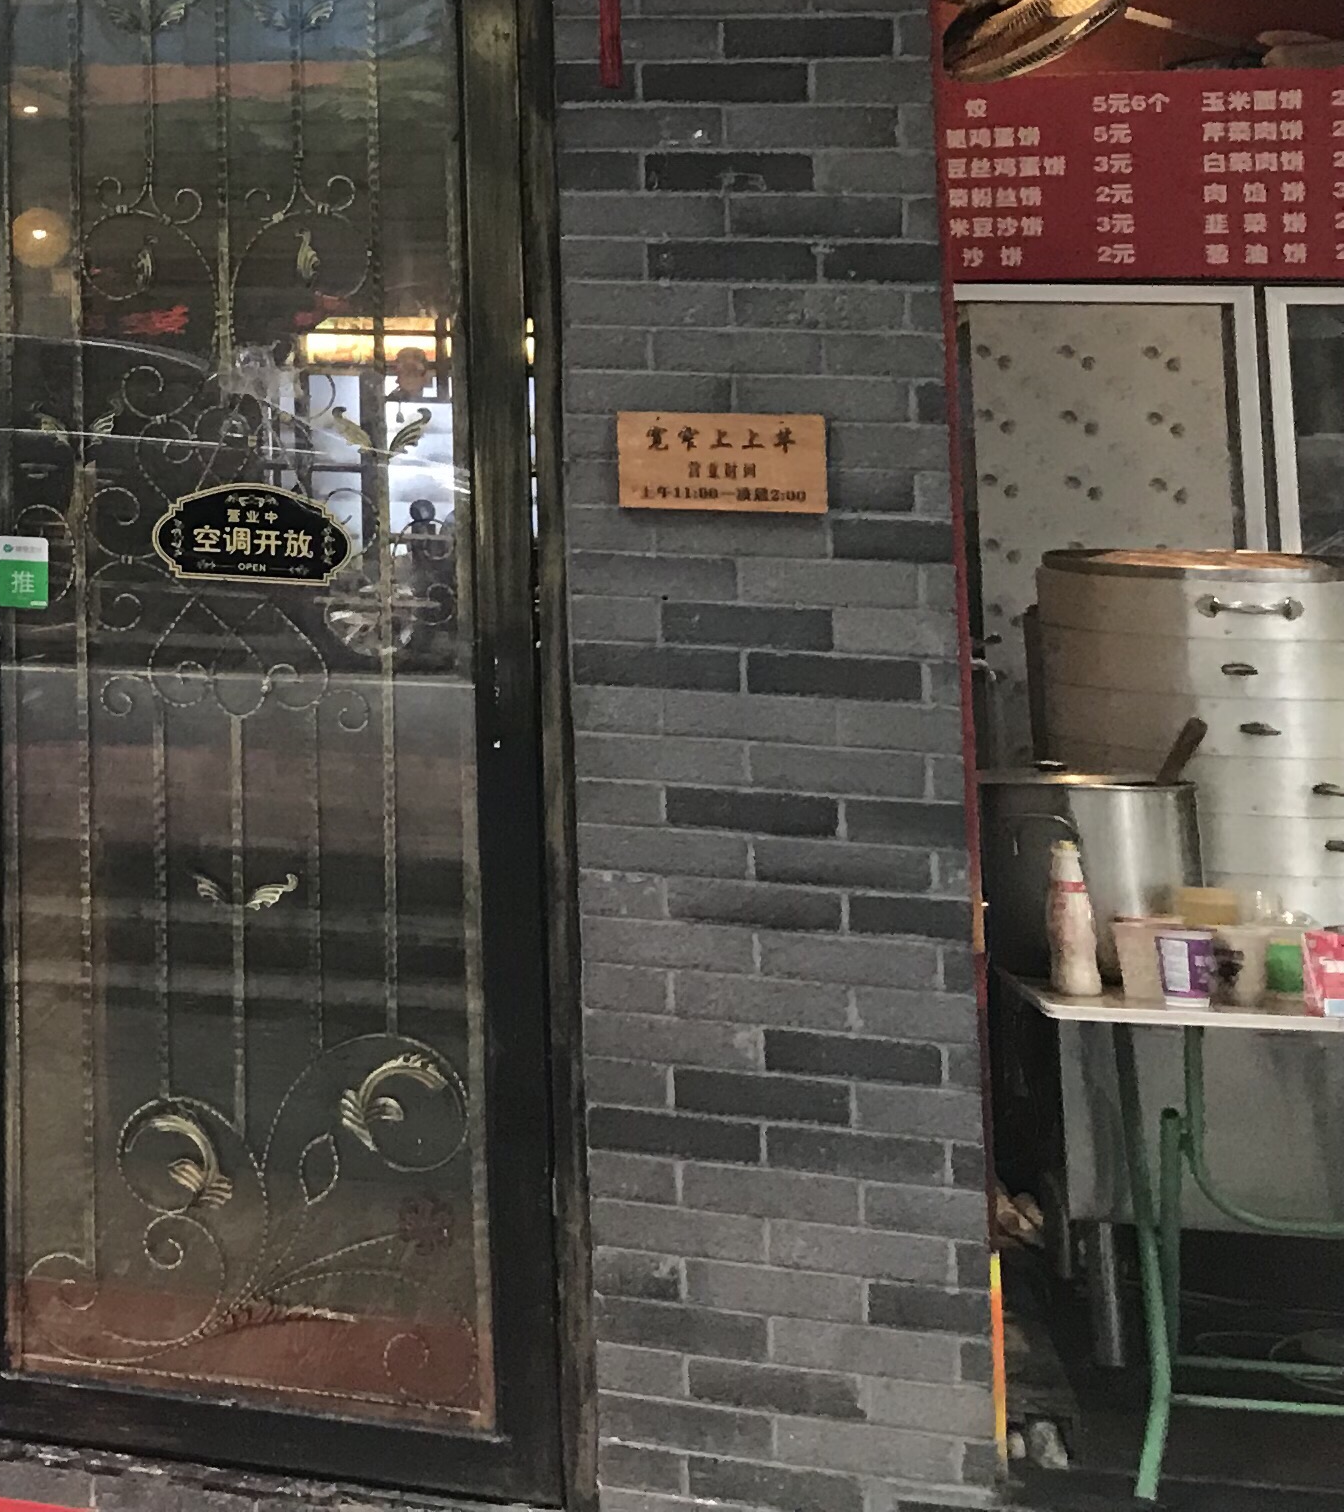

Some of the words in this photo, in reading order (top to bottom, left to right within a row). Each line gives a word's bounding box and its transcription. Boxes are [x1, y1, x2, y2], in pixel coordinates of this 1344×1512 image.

[1092, 93, 1170, 113] 5元6个
[1093, 123, 1132, 143] 5元
[1093, 154, 1133, 174] 3元
[1096, 184, 1133, 204] 2元
[1096, 214, 1135, 234] 3元
[1097, 244, 1136, 264] 2元
[227, 509, 278, 525] 营业中
[192, 525, 314, 559] 空调开放
[238, 563, 267, 573] OPEN
[11, 571, 34, 593] 推
